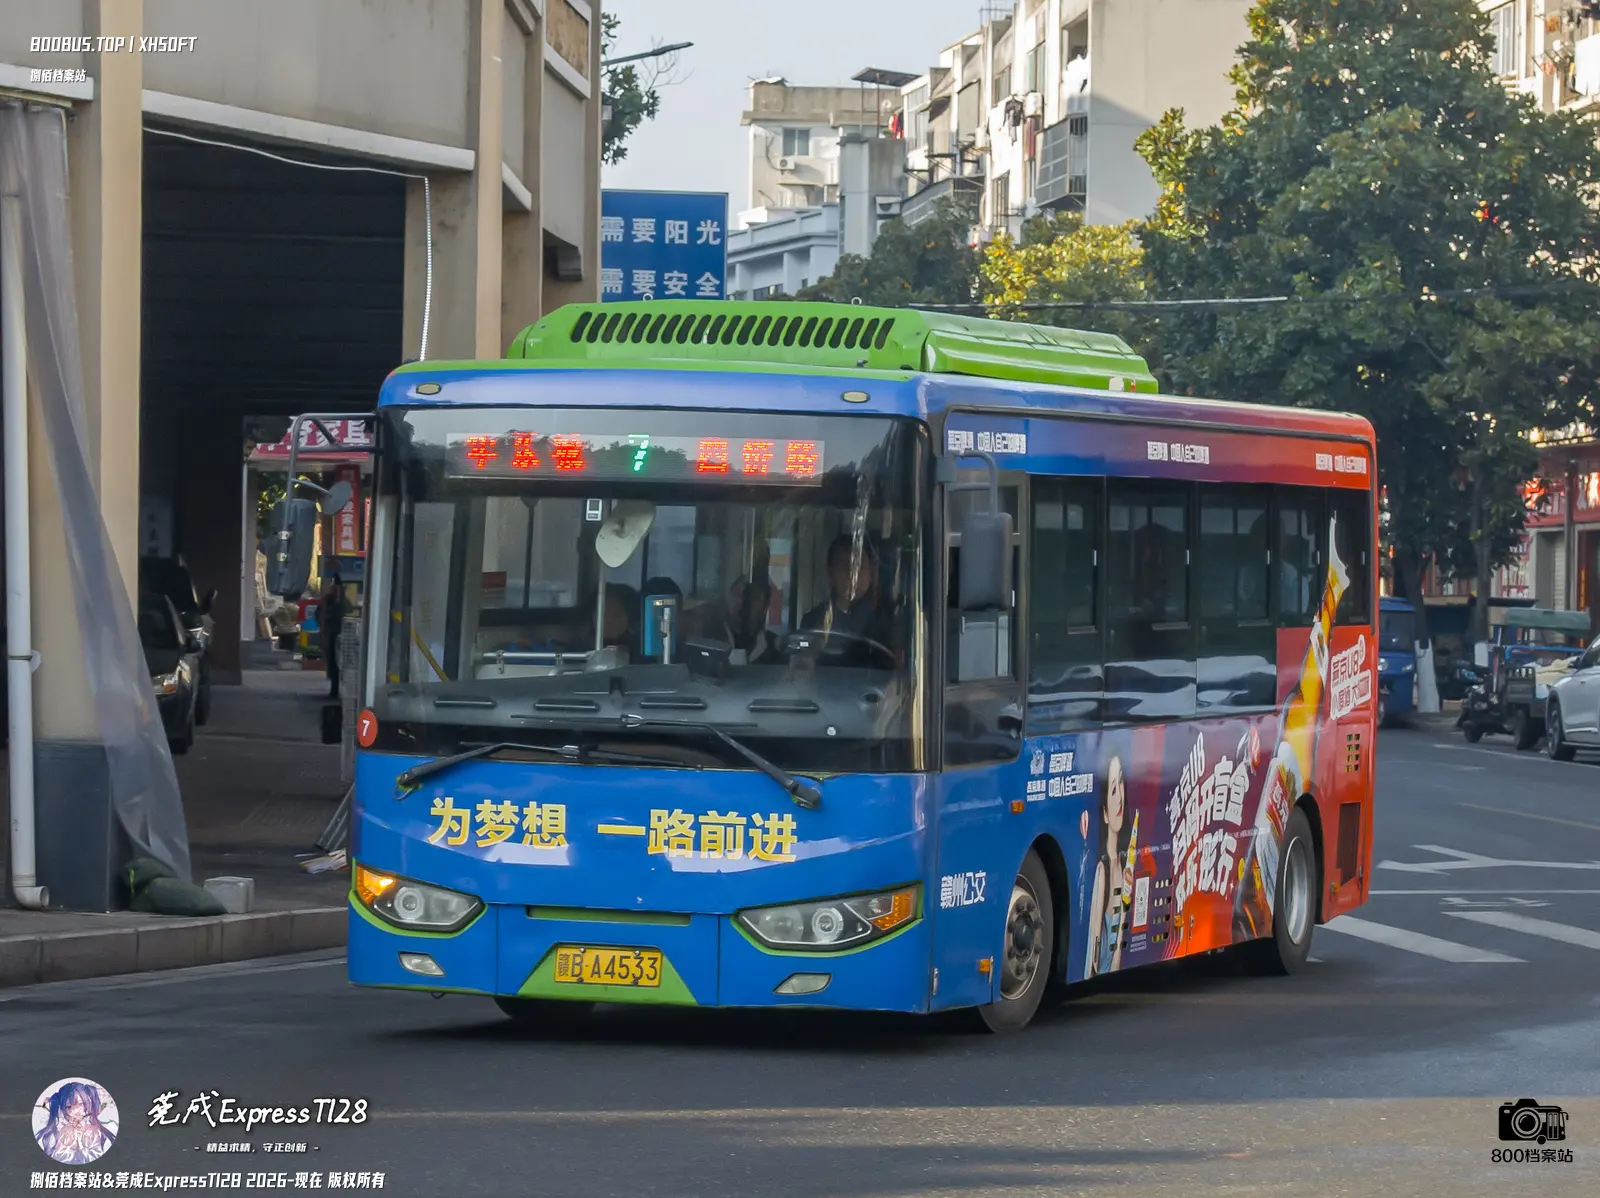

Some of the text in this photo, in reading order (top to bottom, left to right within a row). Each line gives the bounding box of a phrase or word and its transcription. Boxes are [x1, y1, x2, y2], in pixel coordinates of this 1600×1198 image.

[601, 216, 721, 246] 需要阳光
[601, 267, 721, 297] 需要安全
[627, 433, 650, 473] 7
[362, 719, 371, 737] 7
[428, 797, 798, 863] 为梦想 一路前进
[941, 870, 987, 909] 赣州公交
